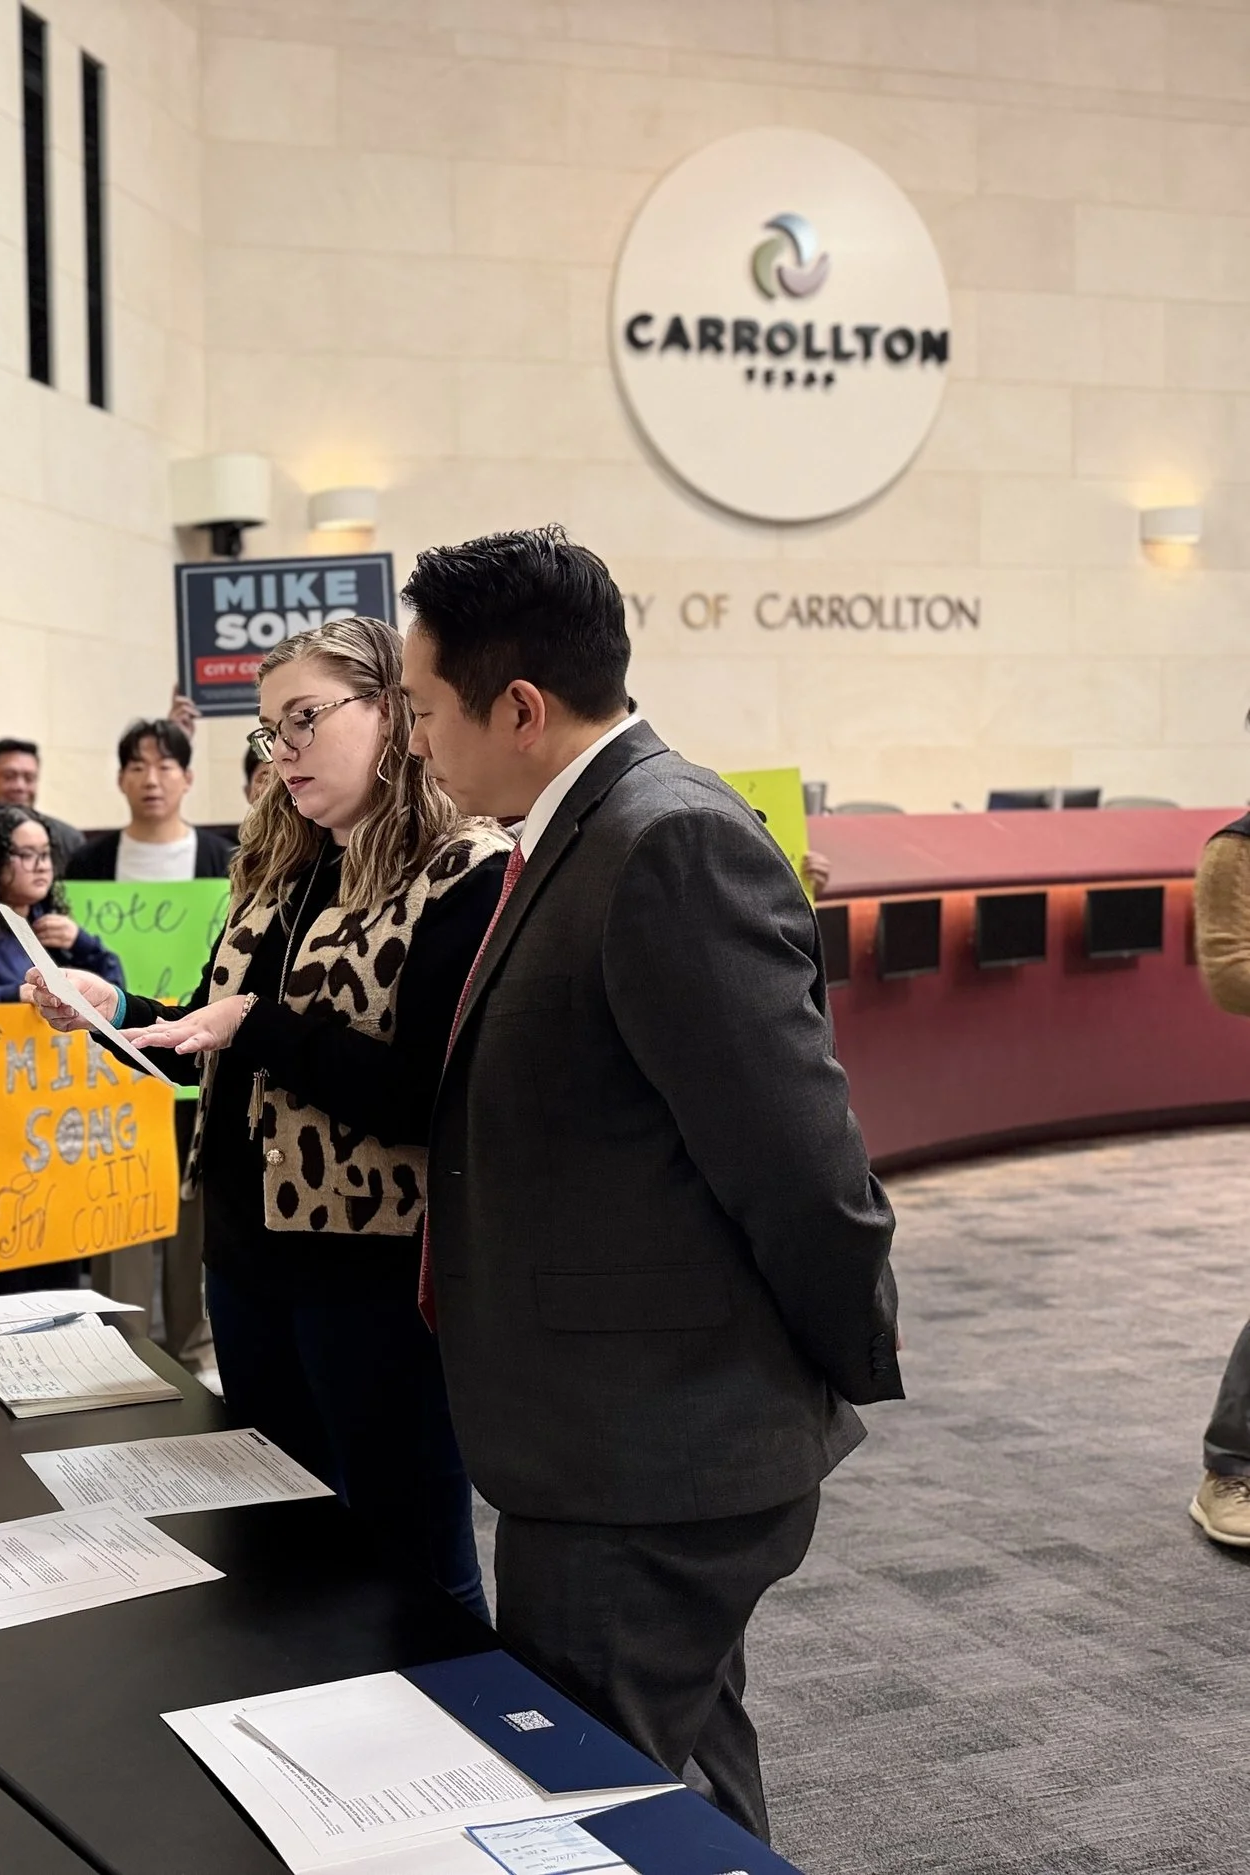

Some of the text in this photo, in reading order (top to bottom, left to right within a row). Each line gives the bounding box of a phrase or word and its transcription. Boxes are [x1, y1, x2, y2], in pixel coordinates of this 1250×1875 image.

[625, 312, 949, 364] CARROLLTON
[213, 570, 358, 612] MIKE
[679, 592, 730, 631] OF
[754, 592, 981, 632] CARROLLTON
[214, 608, 357, 650] SON
[203, 660, 236, 677] CITY
[5, 1035, 150, 1094] MIK
[21, 1102, 137, 1173] SONG
[85, 1148, 150, 1201] CITY
[71, 1190, 167, 1254] COUNCIL
